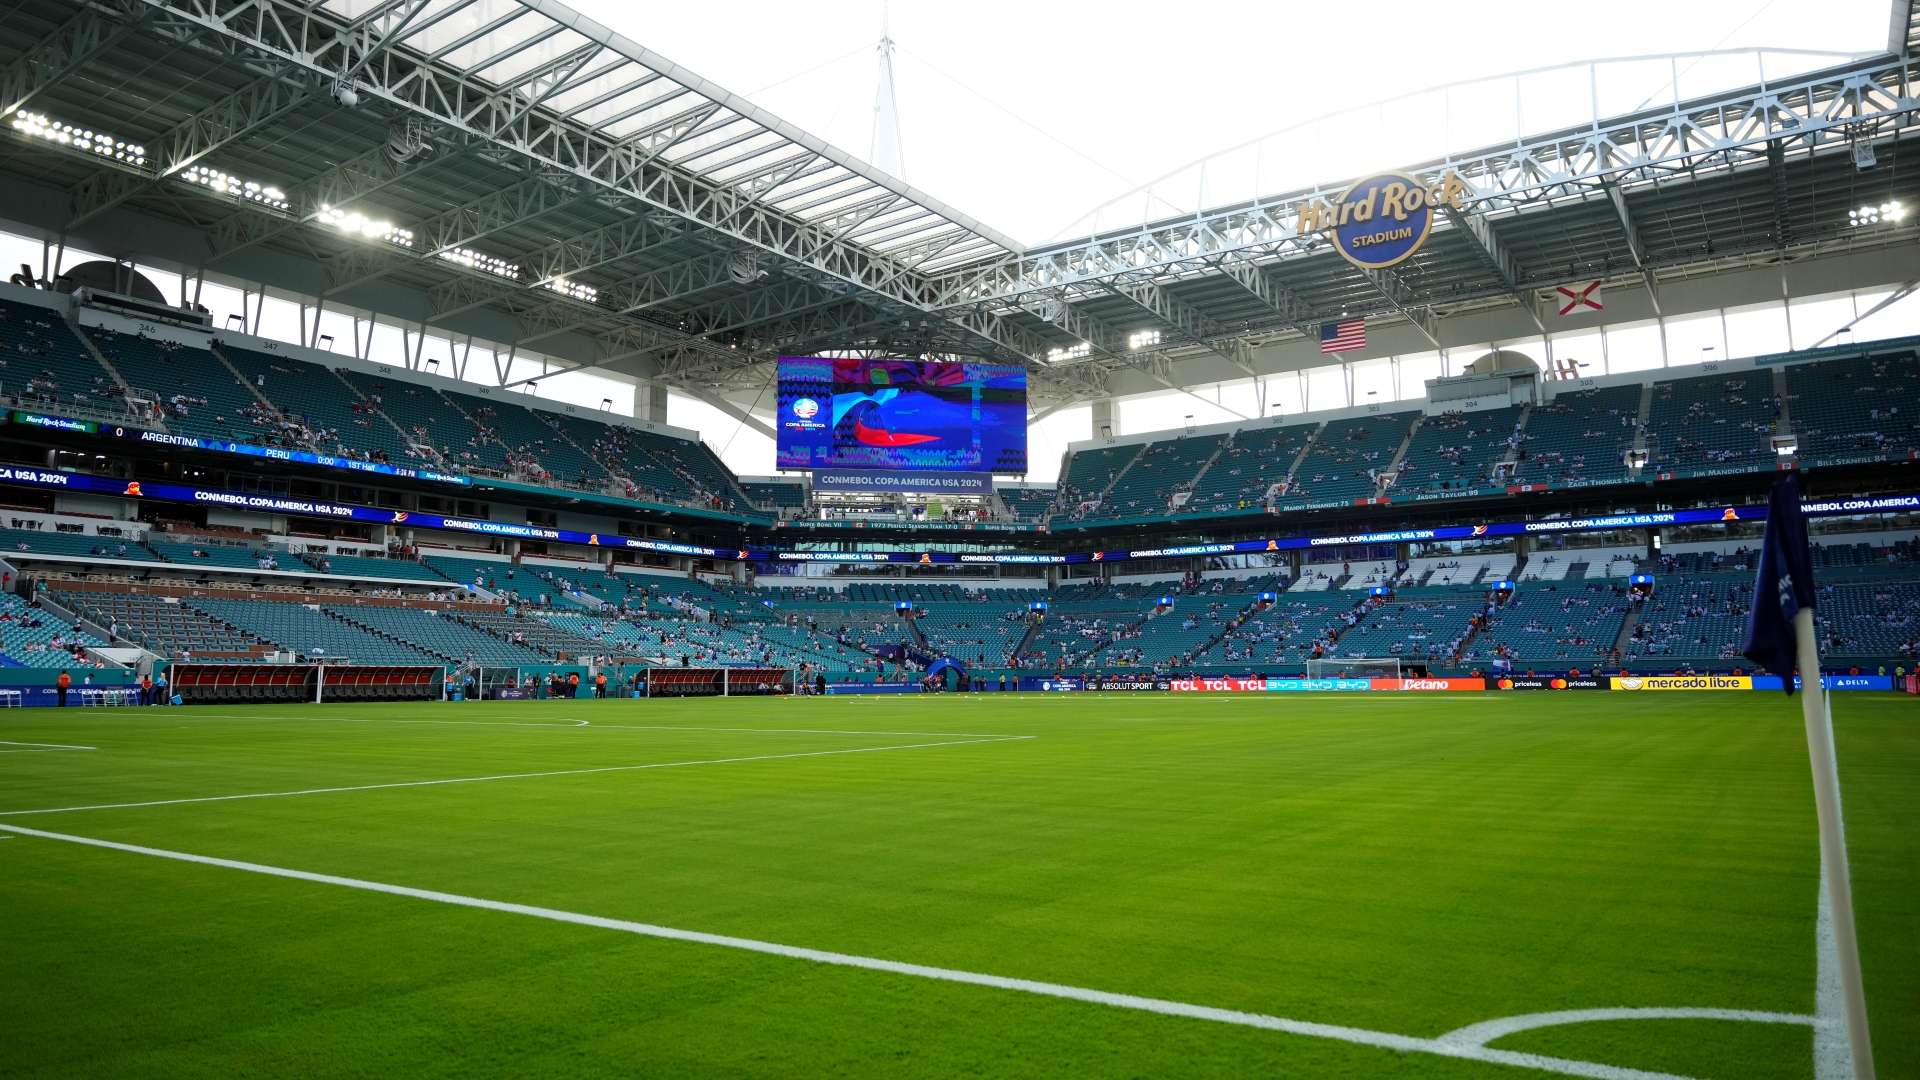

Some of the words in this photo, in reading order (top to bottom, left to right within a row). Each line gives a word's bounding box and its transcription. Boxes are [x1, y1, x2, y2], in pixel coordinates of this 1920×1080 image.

[1296, 187, 1377, 235] Hard
[1380, 170, 1465, 221] Rock
[1352, 226, 1412, 248] STADIUM
[138, 323, 156, 334] 346
[263, 341, 278, 351] 347
[1464, 400, 1478, 408] 304
[26, 415, 43, 425] Hard
[43, 417, 59, 428] Rock
[59, 419, 86, 431] Stadium
[115, 427, 124, 437] 0
[141, 431, 199, 448] ARGENTINA
[265, 448, 290, 460] PERU
[317, 456, 334, 466] 0:00
[1835, 456, 1873, 466] STANFILL
[15, 469, 37, 482] USA
[39, 472, 68, 485] 2024
[1708, 467, 1745, 477] MANDICH
[822, 475, 874, 486] CONMEBOL
[874, 476, 899, 486] COPA
[898, 477, 941, 487] AMERICA
[942, 478, 959, 487] USA
[960, 478, 982, 488] 2024
[1590, 478, 1623, 487] THOMAS
[1416, 492, 1438, 501] JASON
[1439, 490, 1467, 500] TAYLOR
[195, 490, 249, 505] CONMEBOL
[249, 497, 274, 508] COPA
[272, 499, 314, 512] AMERICA
[315, 504, 331, 514] USA
[332, 505, 353, 516] 2024
[1800, 502, 1842, 513] NMEBOL
[1842, 500, 1872, 511] COPA
[1869, 497, 1919, 509] AMERICA
[1525, 521, 1572, 532] CONMEBOL
[1571, 519, 1595, 529] COPA
[1593, 516, 1633, 527] AMERICA
[1634, 515, 1652, 524] USA
[1652, 513, 1675, 523] 2024
[443, 519, 483, 530] CONMEBOL
[483, 523, 501, 532] COPA
[499, 524, 530, 536] AMERICA
[531, 528, 543, 538] USA
[543, 530, 559, 539] 2024
[1310, 536, 1349, 546] CONMEBOL
[1349, 534, 1370, 544] COPA
[1368, 533, 1400, 543] AMERICA
[1400, 531, 1416, 540] USA
[1416, 530, 1434, 539] 2024
[626, 539, 656, 550] CONMEBOL
[656, 542, 670, 551] COPA
[668, 544, 692, 554] AMERICA
[1130, 549, 1163, 558] CONMEBOL
[1162, 548, 1180, 557] COPA
[1177, 546, 1207, 556] AMERICA
[1206, 545, 1219, 553] USA
[1219, 543, 1235, 552] 2024
[779, 552, 815, 561] CONMEBOL
[815, 553, 832, 561] COPA
[830, 553, 860, 562] AMERICA
[861, 553, 873, 562] USA
[873, 553, 889, 562] 2024
[961, 554, 997, 563] CONMEBOL
[997, 555, 1015, 563] COPA
[1013, 555, 1038, 563] AMERICA
[1038, 555, 1051, 563] USA
[1101, 682, 1131, 691] ABSOLUT
[1131, 682, 1153, 691] SPORT
[1171, 680, 1198, 691] TCL
[1204, 680, 1231, 691] TCL
[1238, 680, 1267, 691] TCL
[1404, 679, 1448, 690] Betano
[1514, 679, 1542, 688] priceless
[1568, 679, 1597, 688] priceless
[1647, 677, 1707, 688] mercado
[1708, 676, 1740, 688] libre
